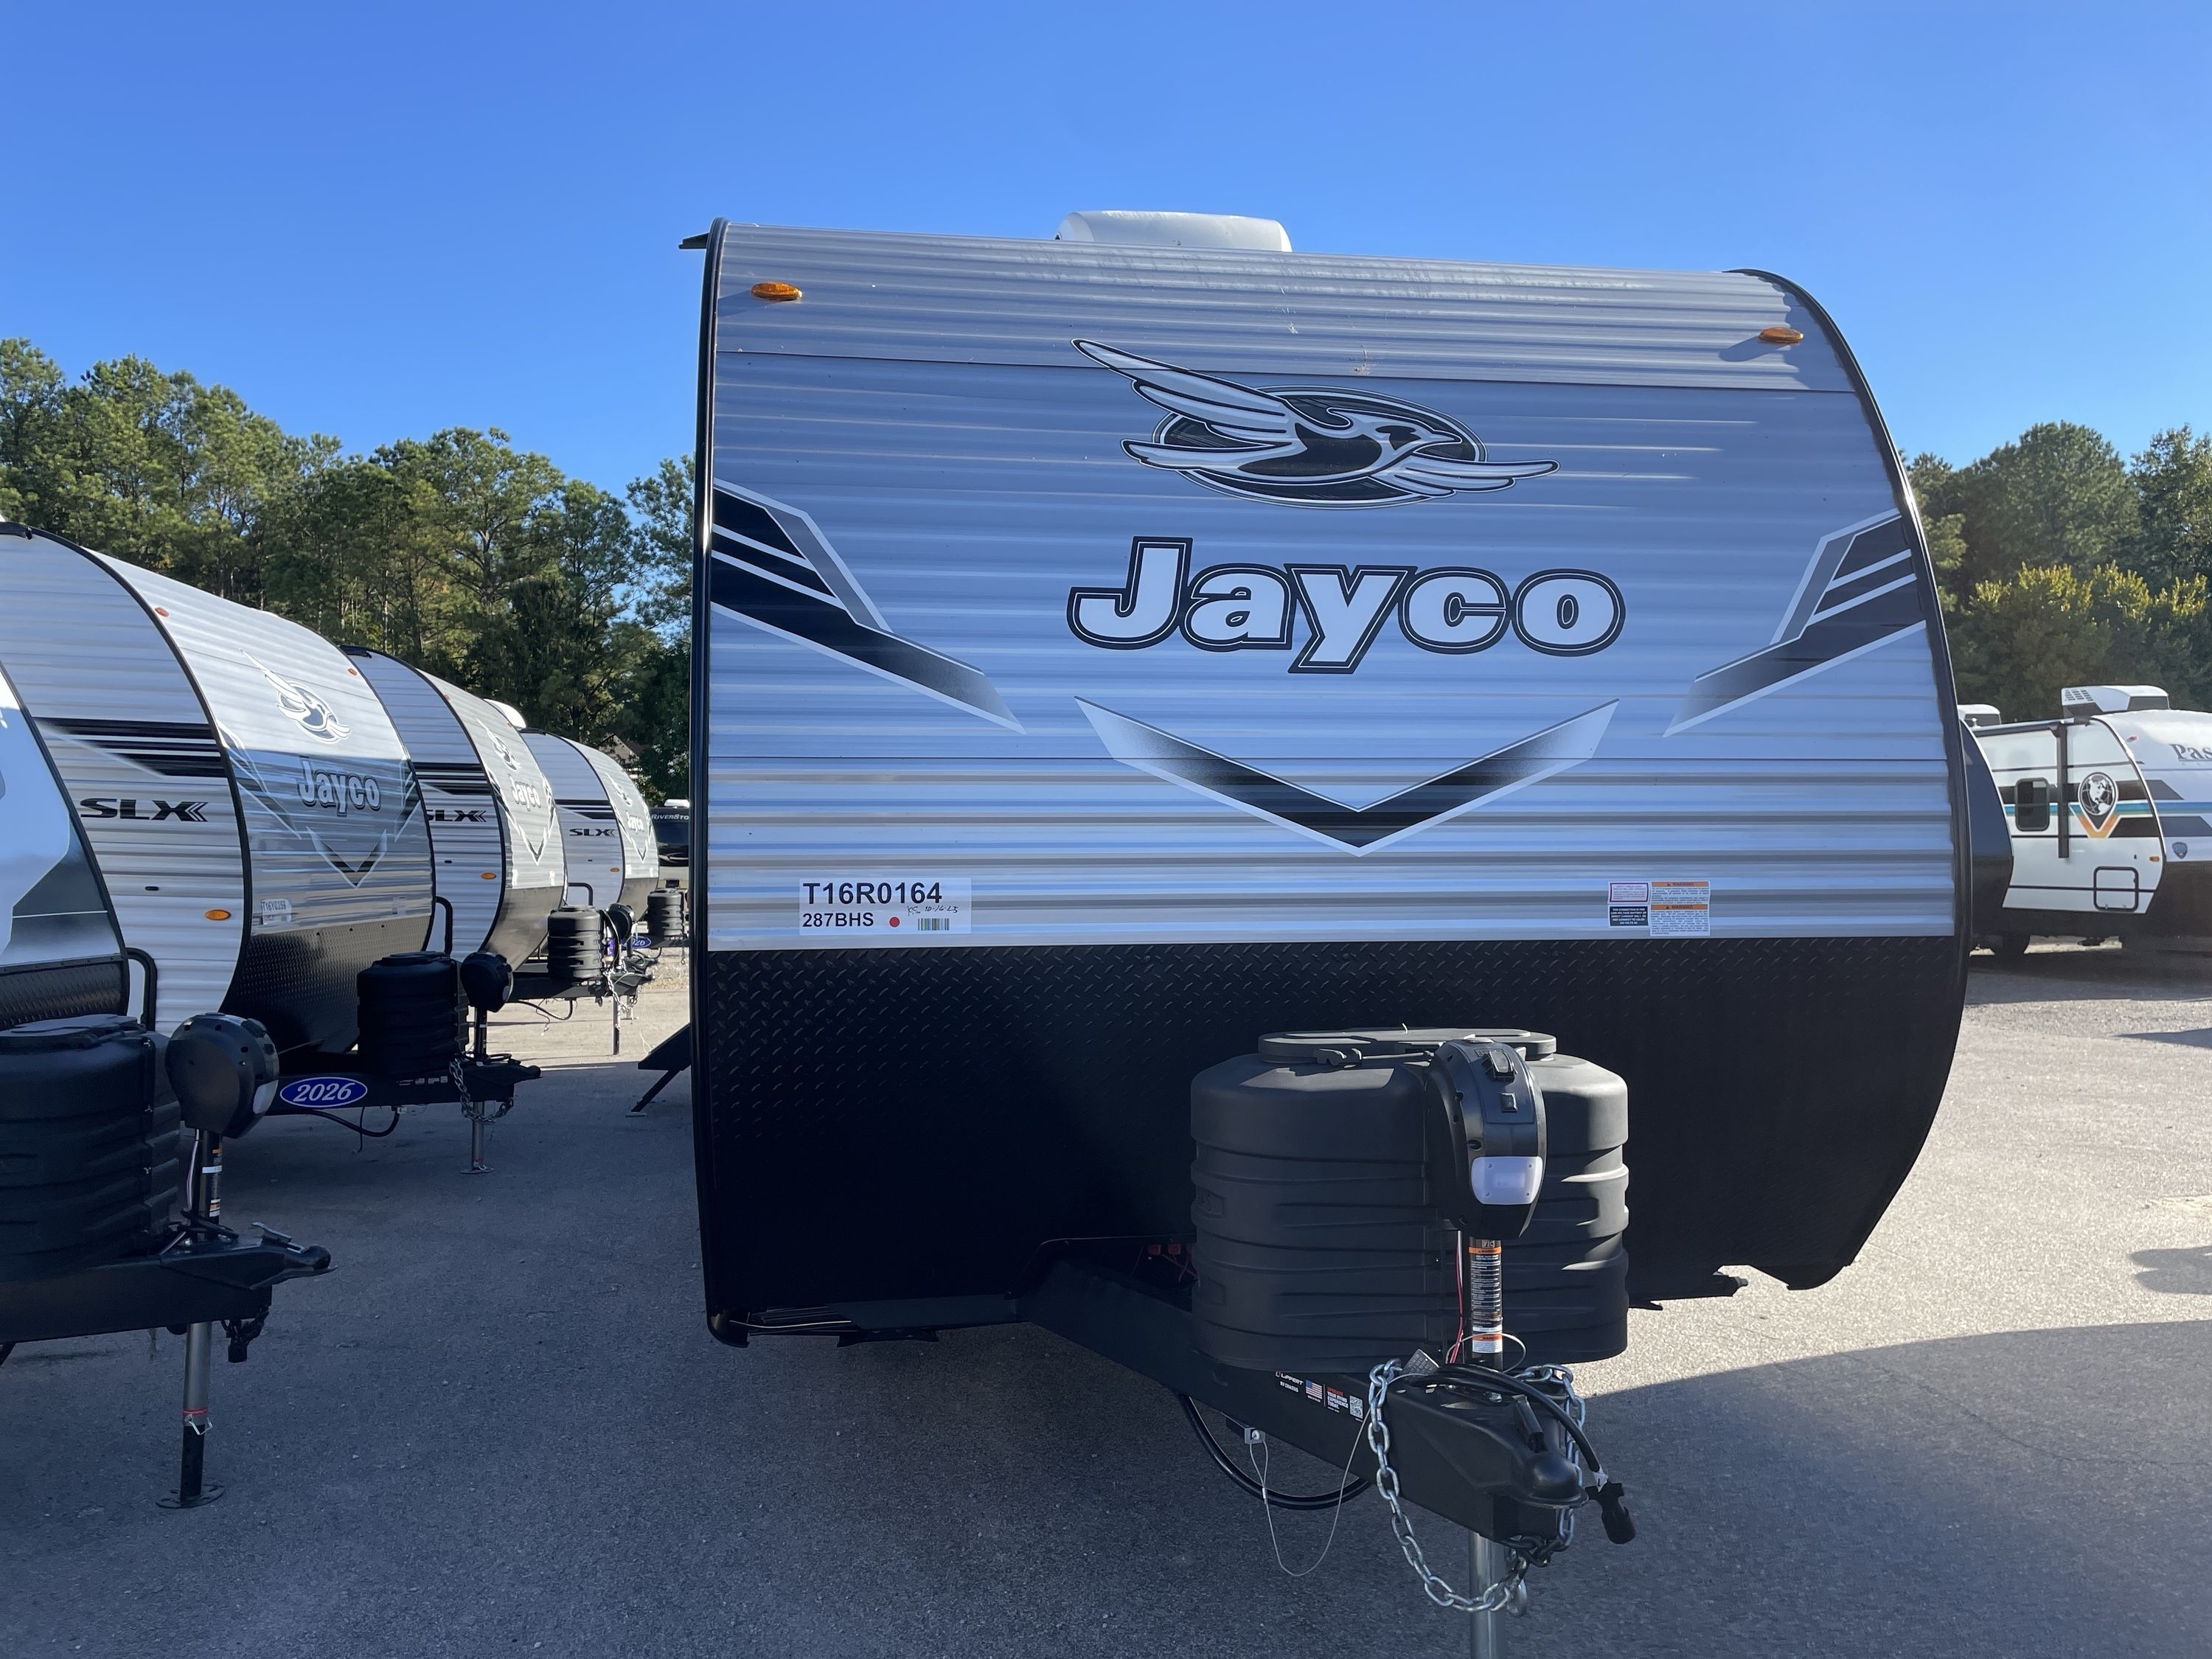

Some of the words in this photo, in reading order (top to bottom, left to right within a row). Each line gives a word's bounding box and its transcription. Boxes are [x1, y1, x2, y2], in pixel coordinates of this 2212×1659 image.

[1067, 536, 1625, 674] Jayco
[296, 755, 381, 818] Jayco
[510, 773, 542, 812] Jayco
[80, 799, 207, 822] SLX
[626, 810, 644, 834] Jayco
[569, 828, 615, 837] SLX
[802, 882, 942, 905] T16R0164
[802, 912, 874, 928] 287BHS
[293, 1082, 355, 1102] 2026
